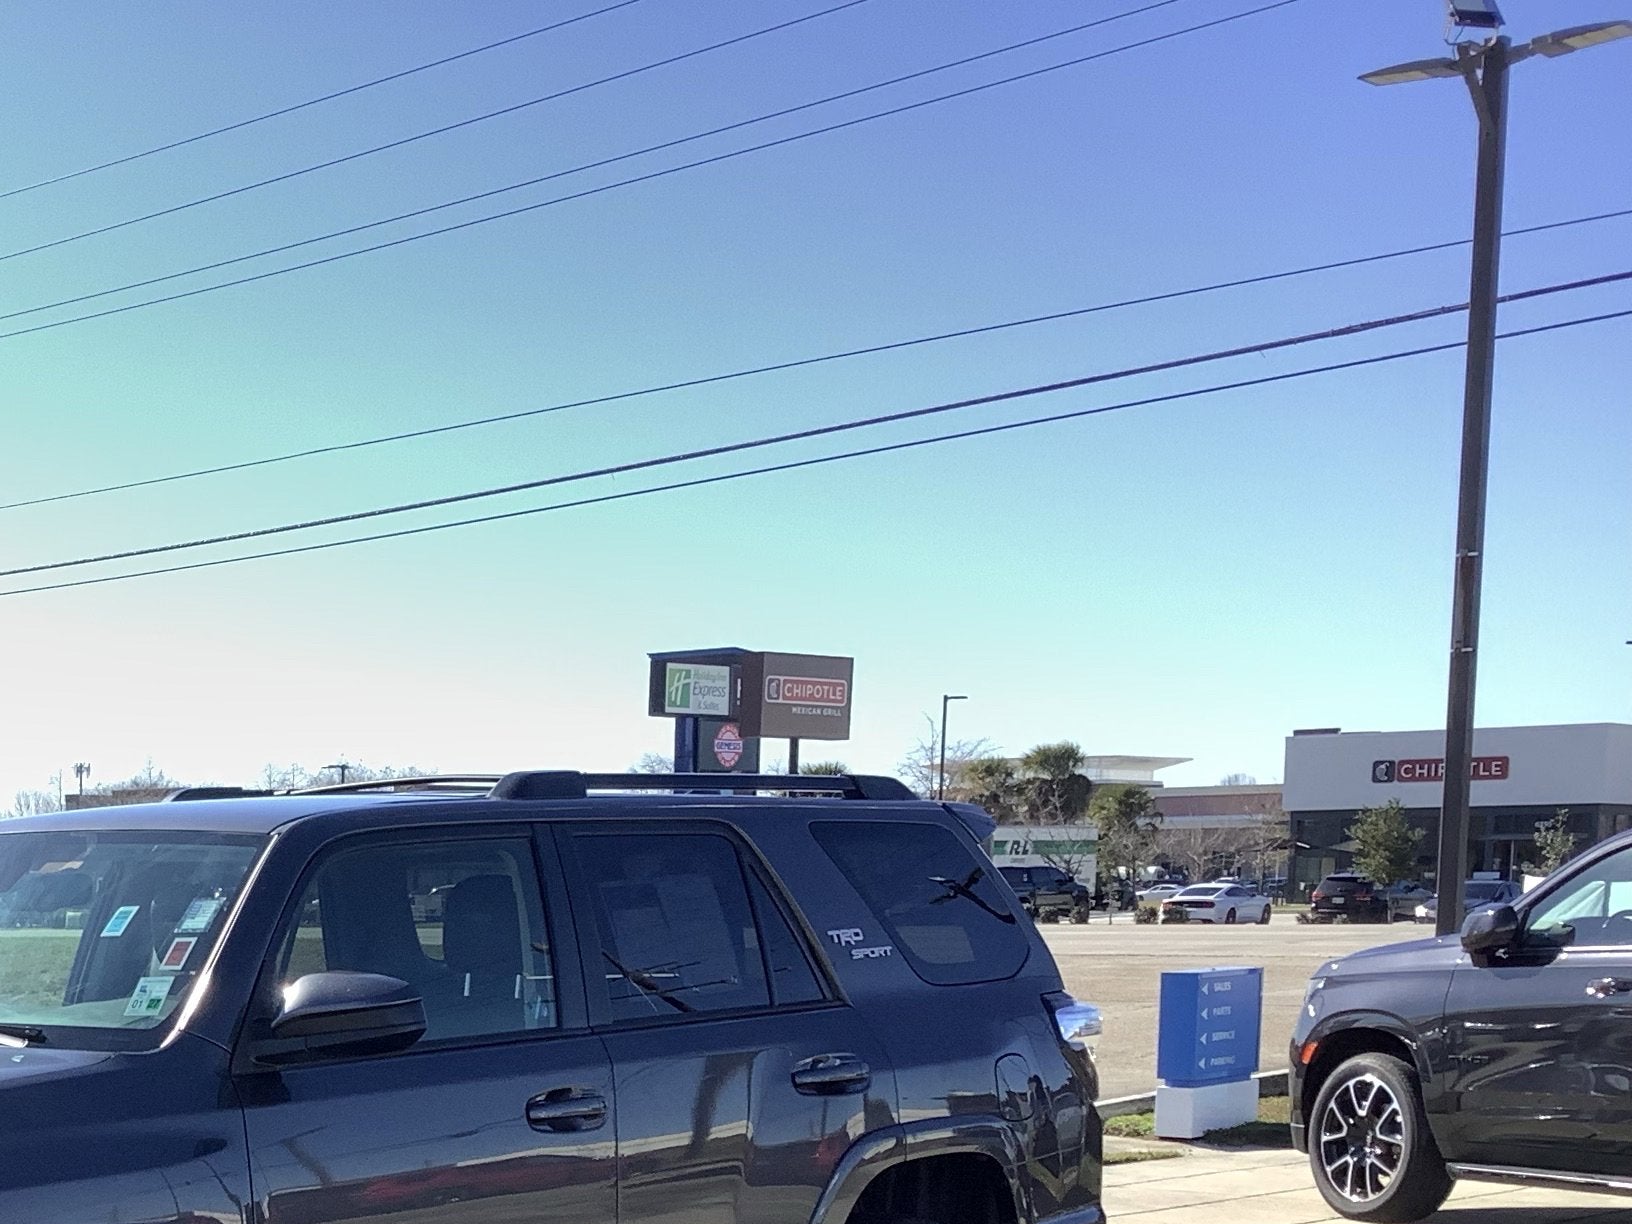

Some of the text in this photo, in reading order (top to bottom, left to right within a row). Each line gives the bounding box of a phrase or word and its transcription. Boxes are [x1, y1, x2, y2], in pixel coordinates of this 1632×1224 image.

[693, 682, 726, 699] Express
[784, 683, 843, 700] CHIPOTLE
[792, 706, 841, 716] MEXICAN GRILL
[716, 741, 741, 750] GENESIS
[1401, 761, 1502, 778] CHIPTLE
[827, 928, 864, 946] TRD
[851, 946, 893, 959] SPORT
[1213, 982, 1232, 992] SALES
[1213, 1006, 1231, 1016] PARTS
